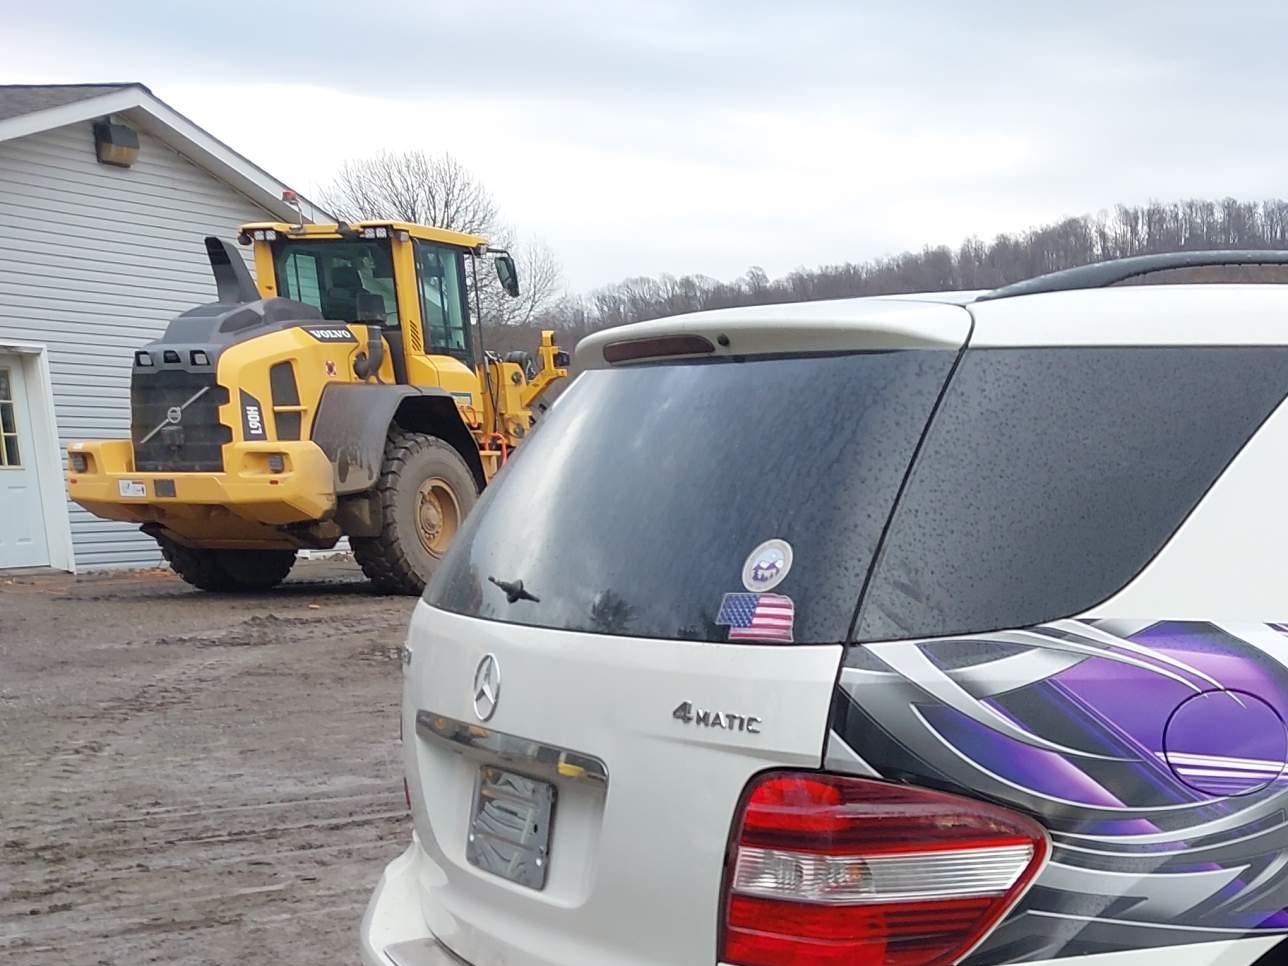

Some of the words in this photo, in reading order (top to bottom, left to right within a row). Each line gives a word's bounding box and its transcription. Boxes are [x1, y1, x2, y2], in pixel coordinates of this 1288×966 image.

[309, 330, 351, 339] VOLVO
[245, 406, 263, 434] L90H
[672, 700, 762, 734] 4MATIC
